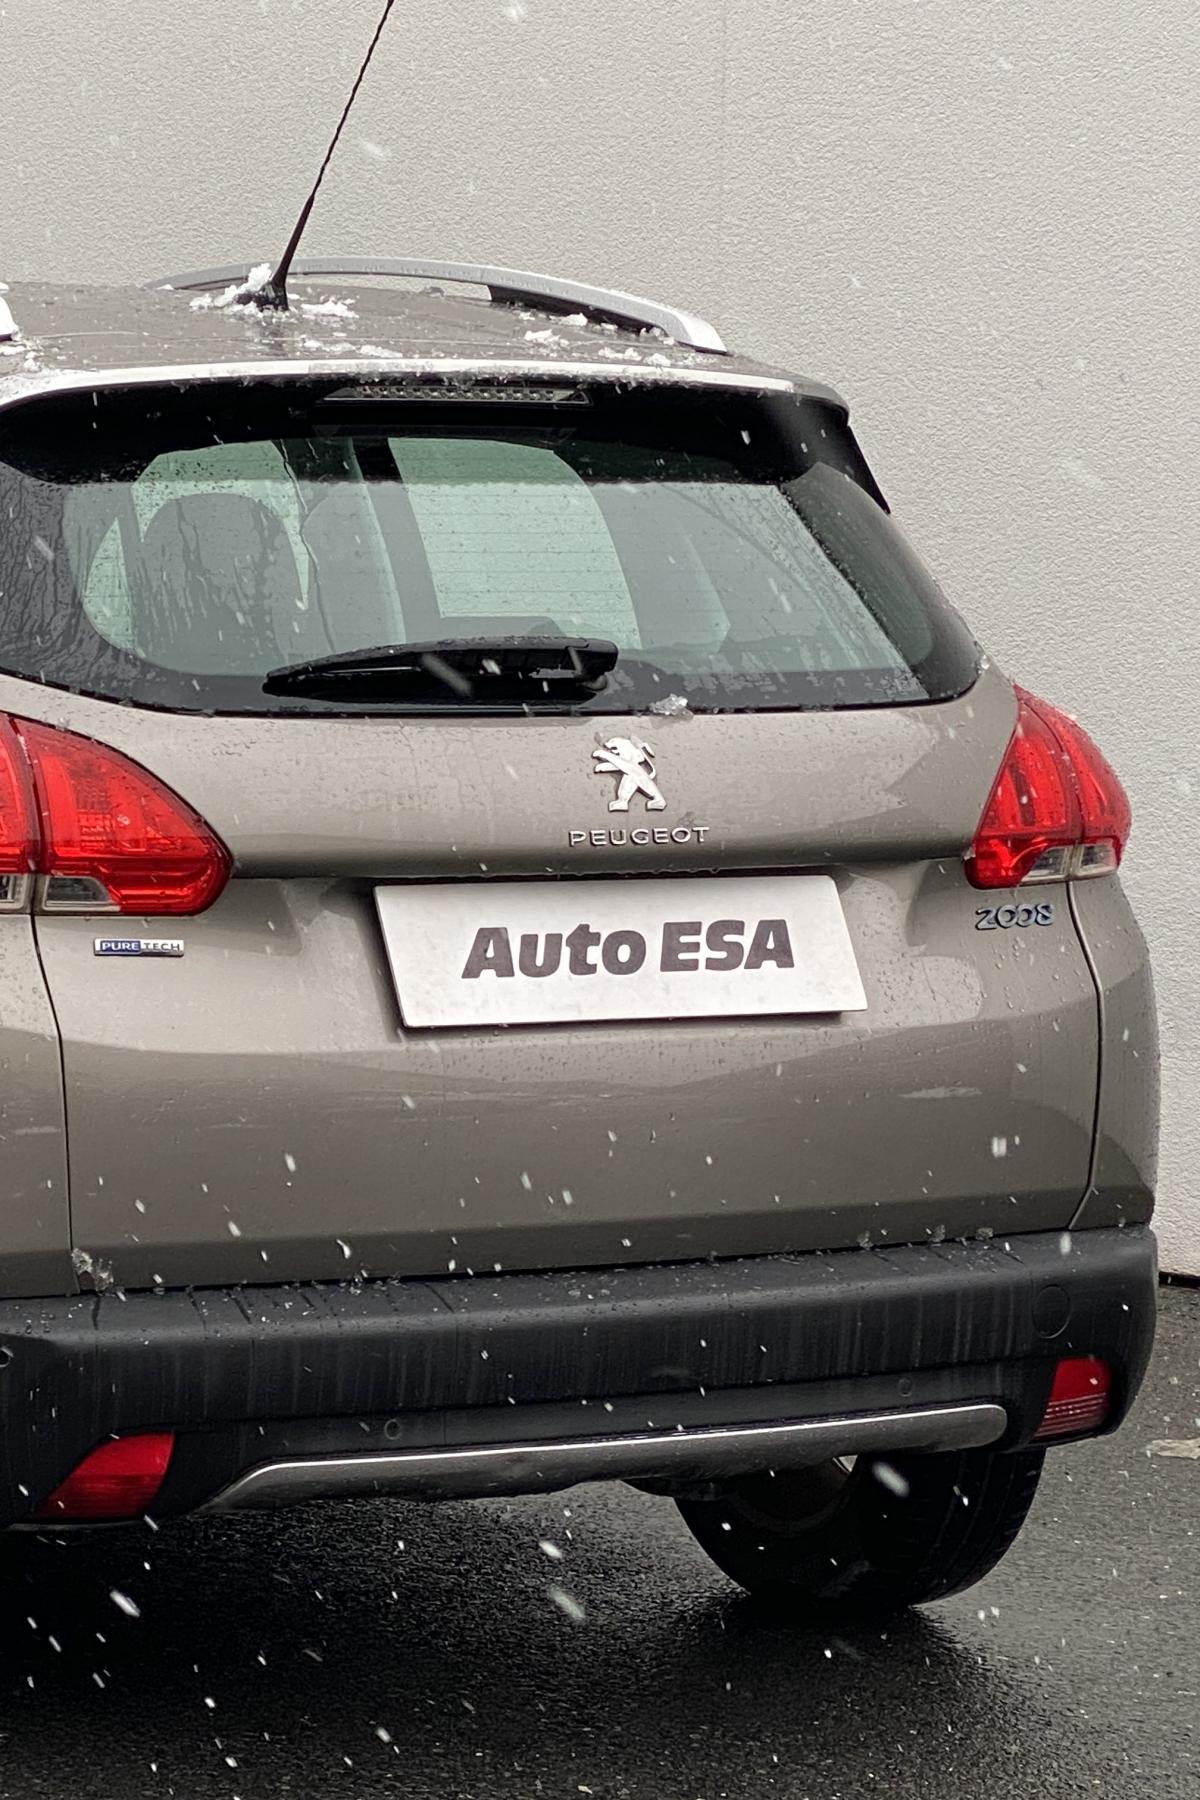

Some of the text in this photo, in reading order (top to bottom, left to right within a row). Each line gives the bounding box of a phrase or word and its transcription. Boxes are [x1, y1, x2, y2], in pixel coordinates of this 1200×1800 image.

[570, 827, 710, 847] PEUGEOT
[975, 904, 1056, 930] 2008
[461, 919, 795, 979] Auto ESA
